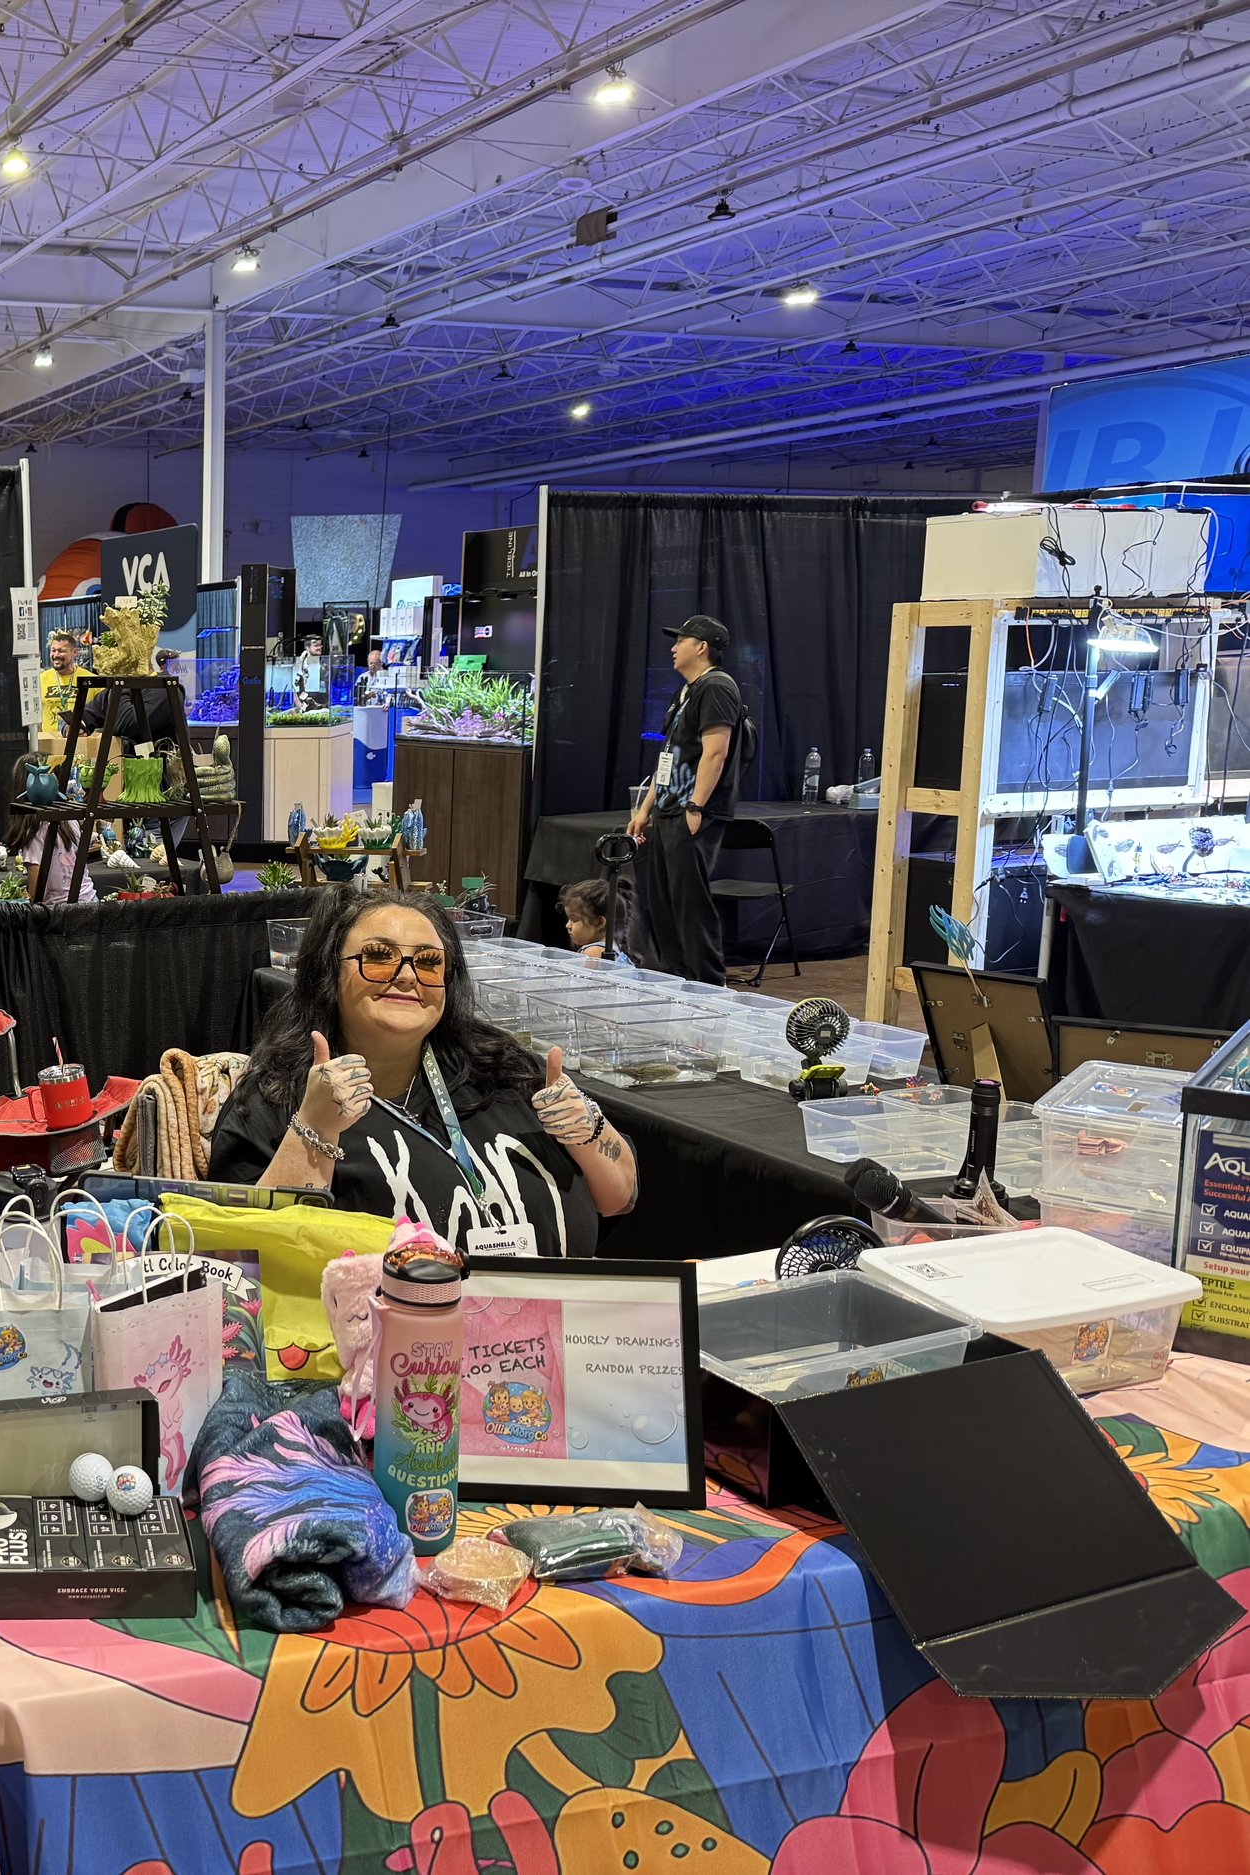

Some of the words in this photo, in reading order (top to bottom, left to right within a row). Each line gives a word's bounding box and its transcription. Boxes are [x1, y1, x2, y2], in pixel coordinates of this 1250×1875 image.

[506, 531, 514, 578] TIDELINE
[122, 551, 170, 596] VCA
[1204, 1179, 1245, 1192] Essentials
[1203, 1188, 1247, 1202] Successful
[475, 1241, 516, 1251] AQUASHELLA
[201, 1260, 233, 1281] Book
[1203, 1261, 1229, 1274] Setup
[565, 1334, 610, 1345] HOURLY
[615, 1336, 681, 1348] DRAWINGS
[411, 1342, 453, 1357] STAY
[469, 1337, 546, 1360] TICKETS
[499, 1354, 546, 1373] EACH
[586, 1363, 634, 1374] RANDOM
[416, 1441, 444, 1454] AND
[9, 1532, 29, 1565] PLUS
